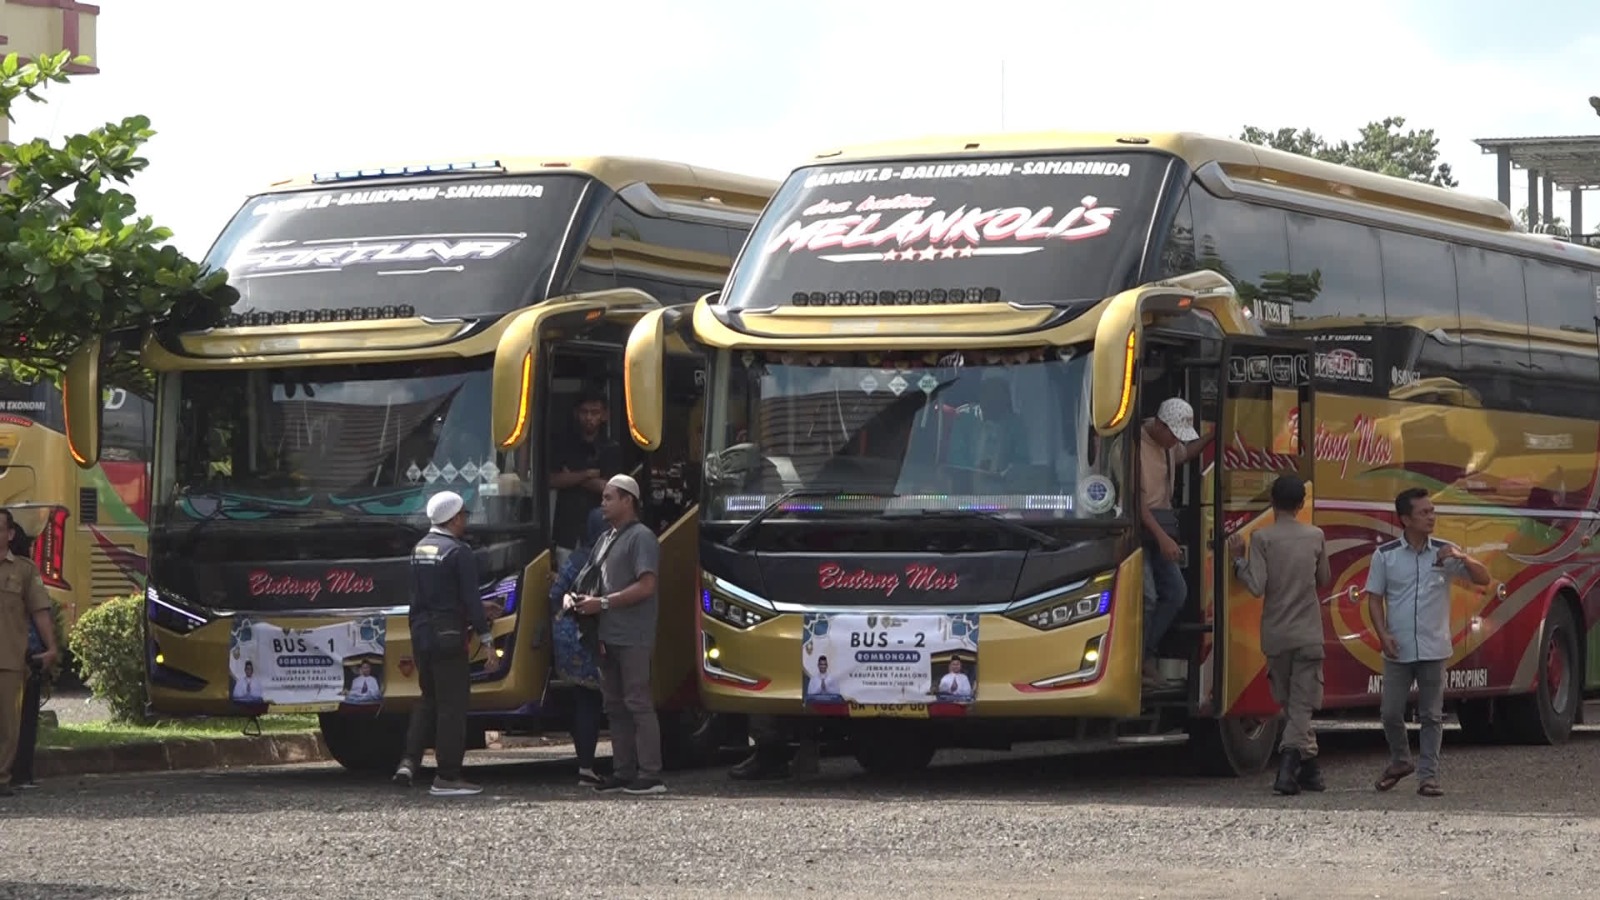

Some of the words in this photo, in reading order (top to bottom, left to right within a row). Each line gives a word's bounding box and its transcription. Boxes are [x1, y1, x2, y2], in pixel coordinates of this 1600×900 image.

[7, 402, 46, 411] EKONOMI
[1354, 413, 1392, 466] Mas
[248, 569, 321, 600] Bintang
[326, 568, 374, 594] Mas
[818, 562, 899, 597] Bintang
[905, 562, 960, 591] Mas
[273, 638, 307, 652] BUS
[328, 638, 334, 652] 1
[850, 632, 888, 647] BUS
[914, 632, 925, 647] 2
[857, 653, 919, 661] ROMBONGAN
[1367, 674, 1384, 694] ANT
[1450, 668, 1488, 688] PROPINSI
